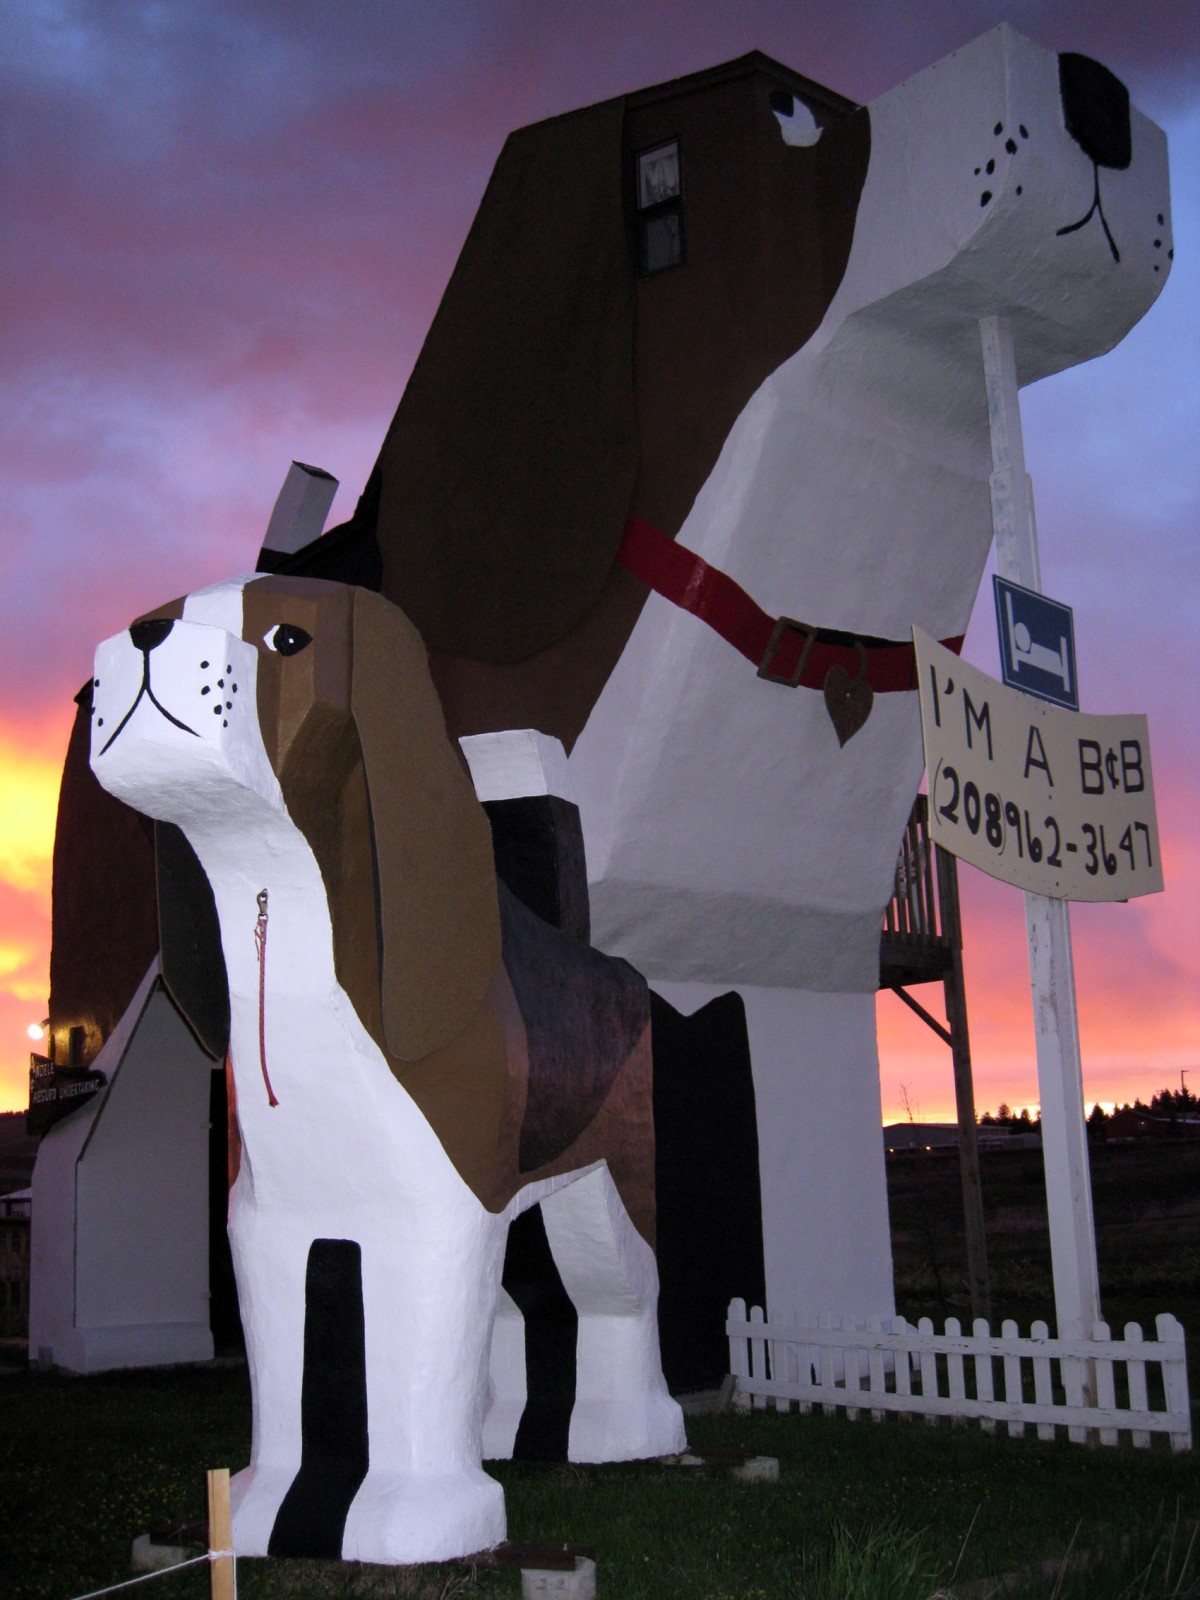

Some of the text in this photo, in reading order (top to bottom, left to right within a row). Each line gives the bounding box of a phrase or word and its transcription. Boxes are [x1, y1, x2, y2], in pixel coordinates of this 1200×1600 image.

[930, 664, 993, 761] I'M
[1023, 725, 1054, 787] A
[59, 1079, 100, 1099] UNDERTAKING
